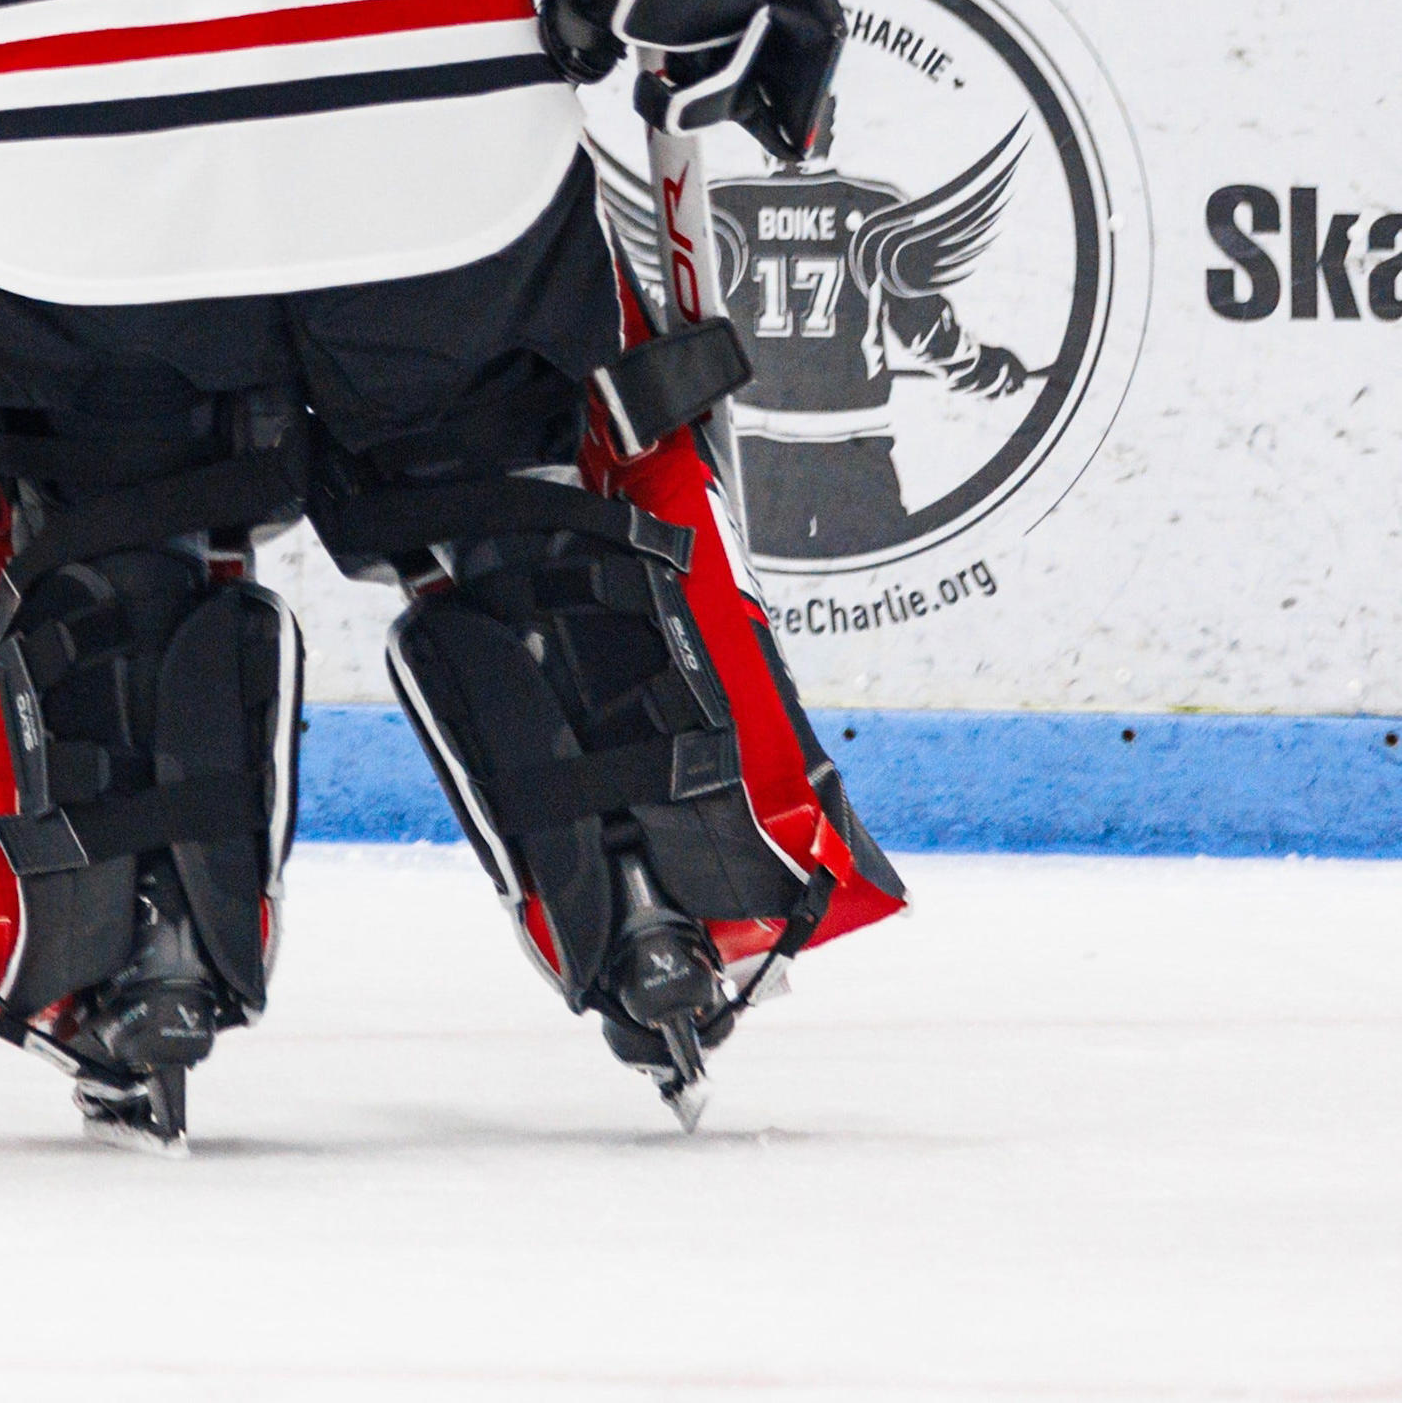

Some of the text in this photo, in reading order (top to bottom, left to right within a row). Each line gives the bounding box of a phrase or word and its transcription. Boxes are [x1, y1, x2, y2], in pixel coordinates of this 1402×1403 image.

[843, 6, 953, 83] HARLIE
[757, 207, 837, 240] BOIKE
[751, 253, 845, 338] 17
